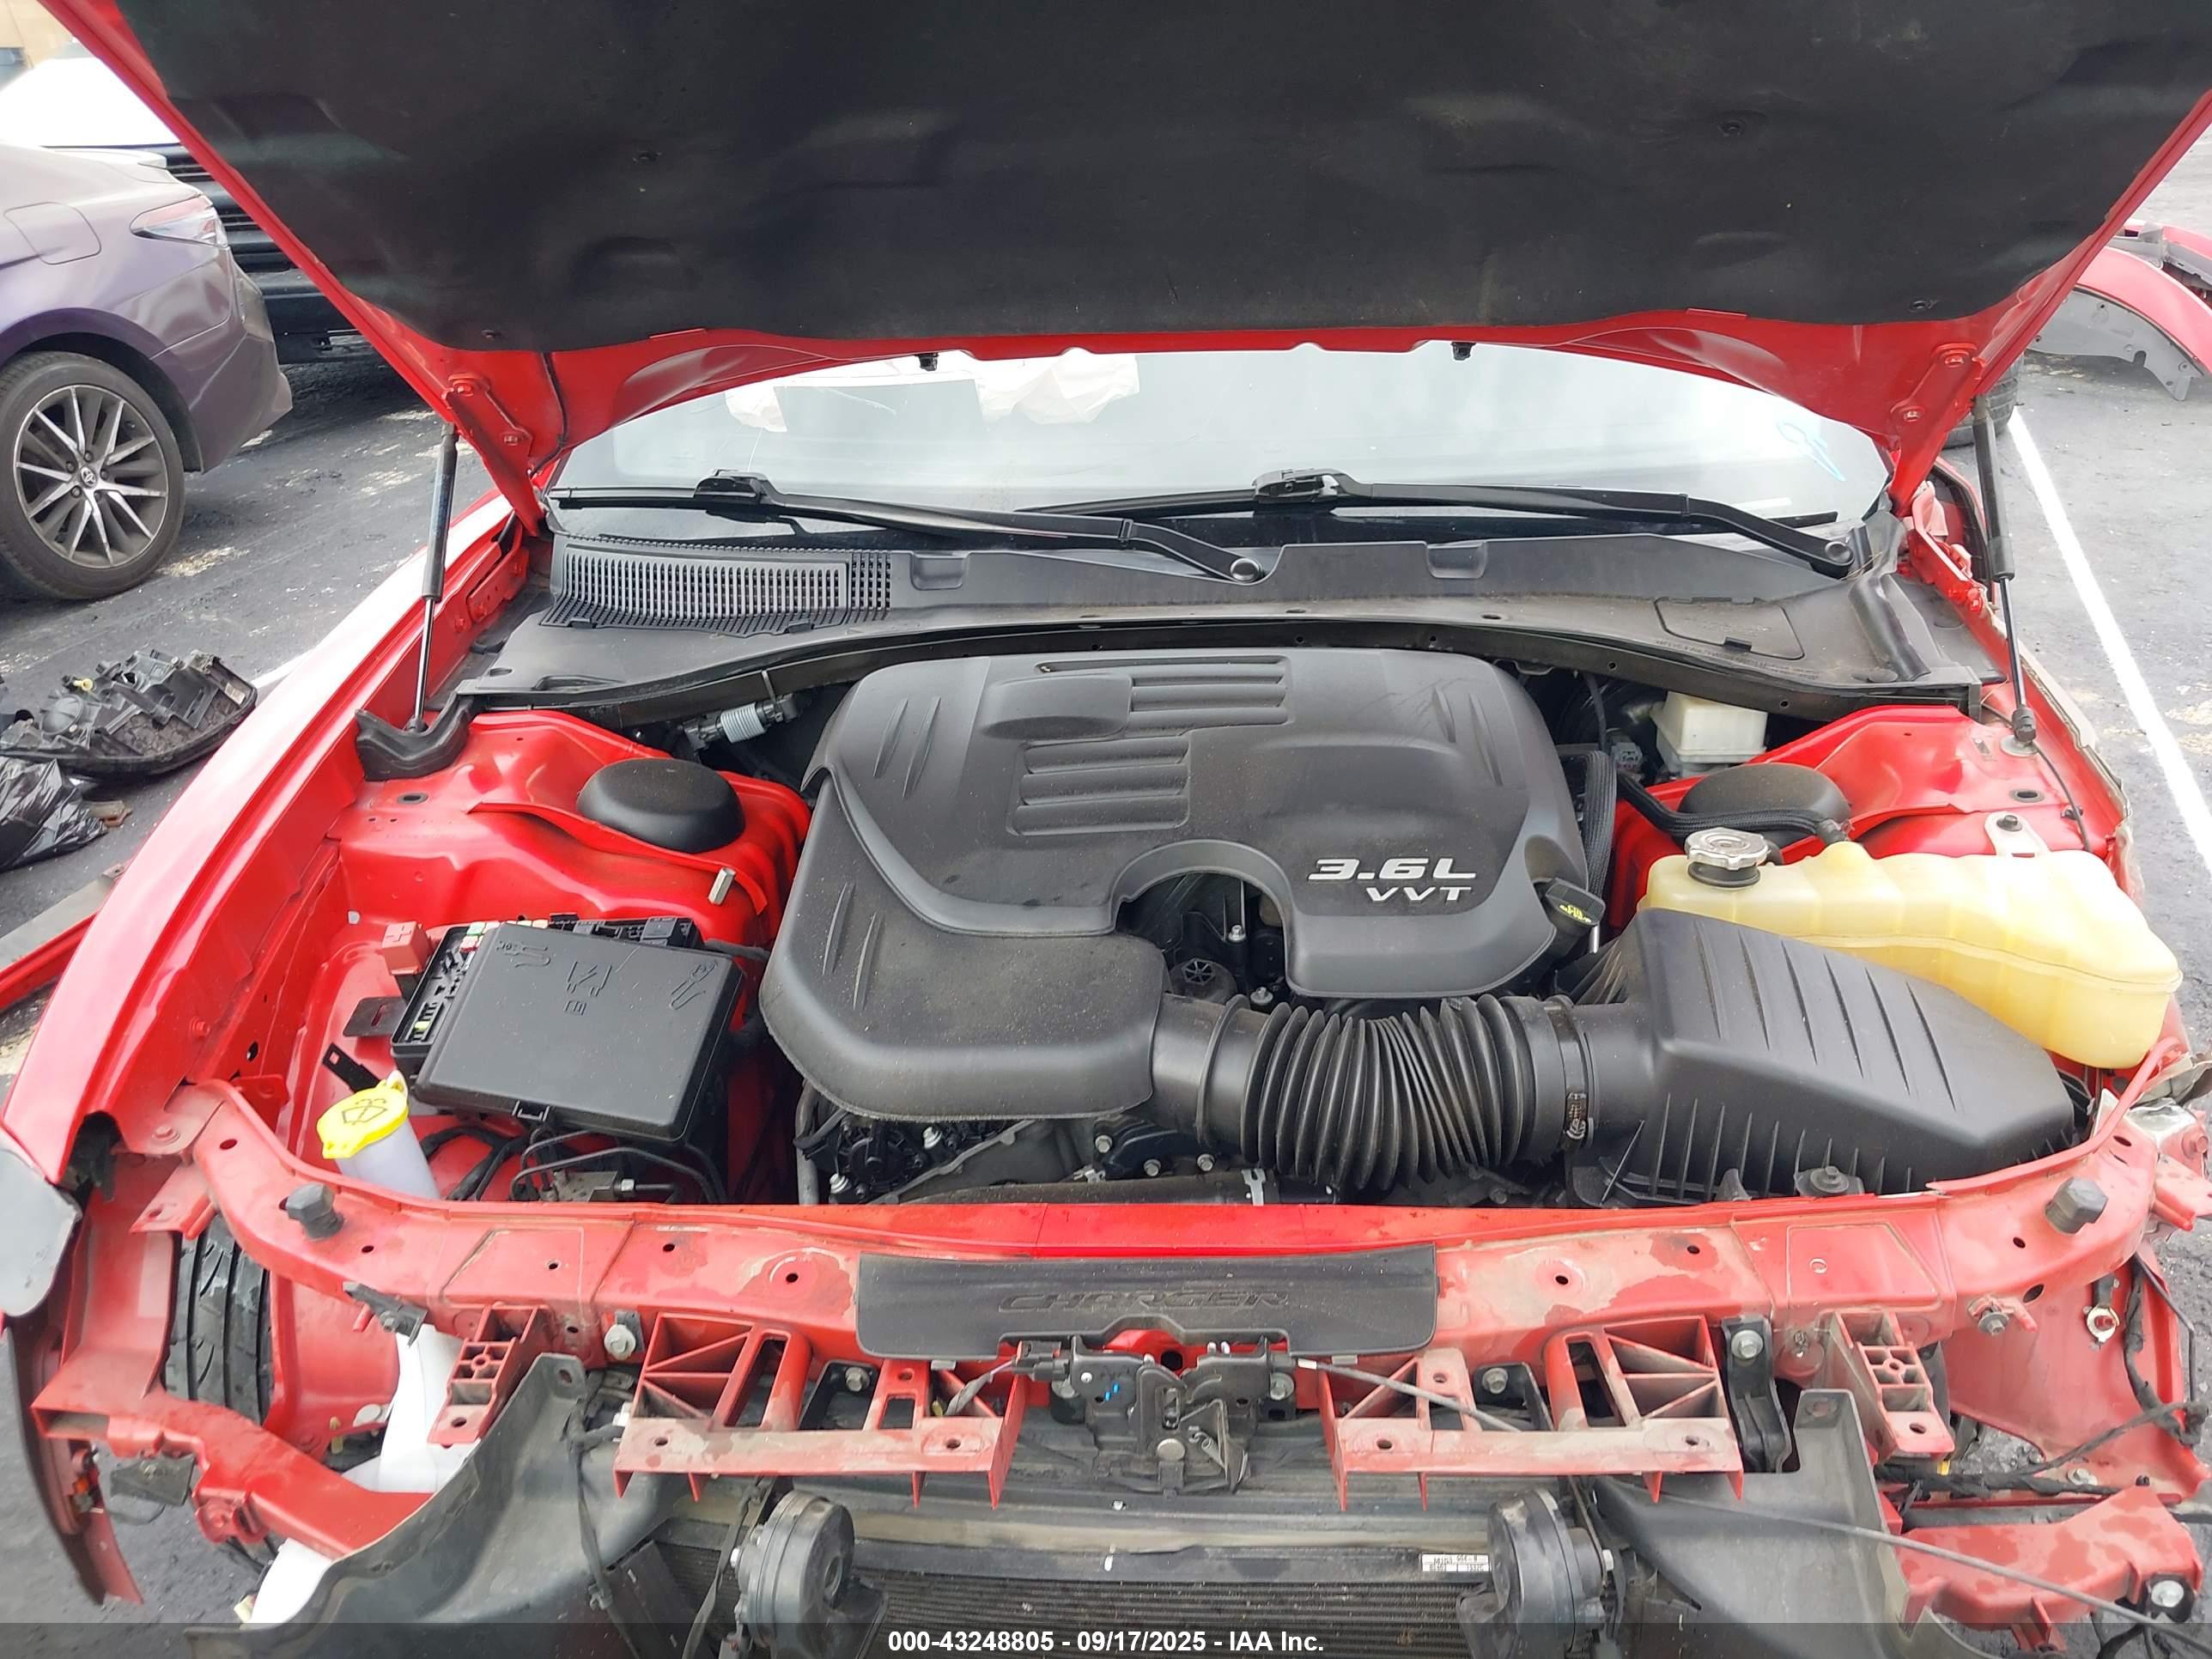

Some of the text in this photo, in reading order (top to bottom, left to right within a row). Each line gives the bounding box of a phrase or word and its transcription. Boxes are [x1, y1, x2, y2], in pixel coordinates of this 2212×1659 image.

[1308, 858, 1476, 880] 3.6L
[1365, 886, 1472, 902] VVT
[998, 1291, 1289, 1312] CHARGER
